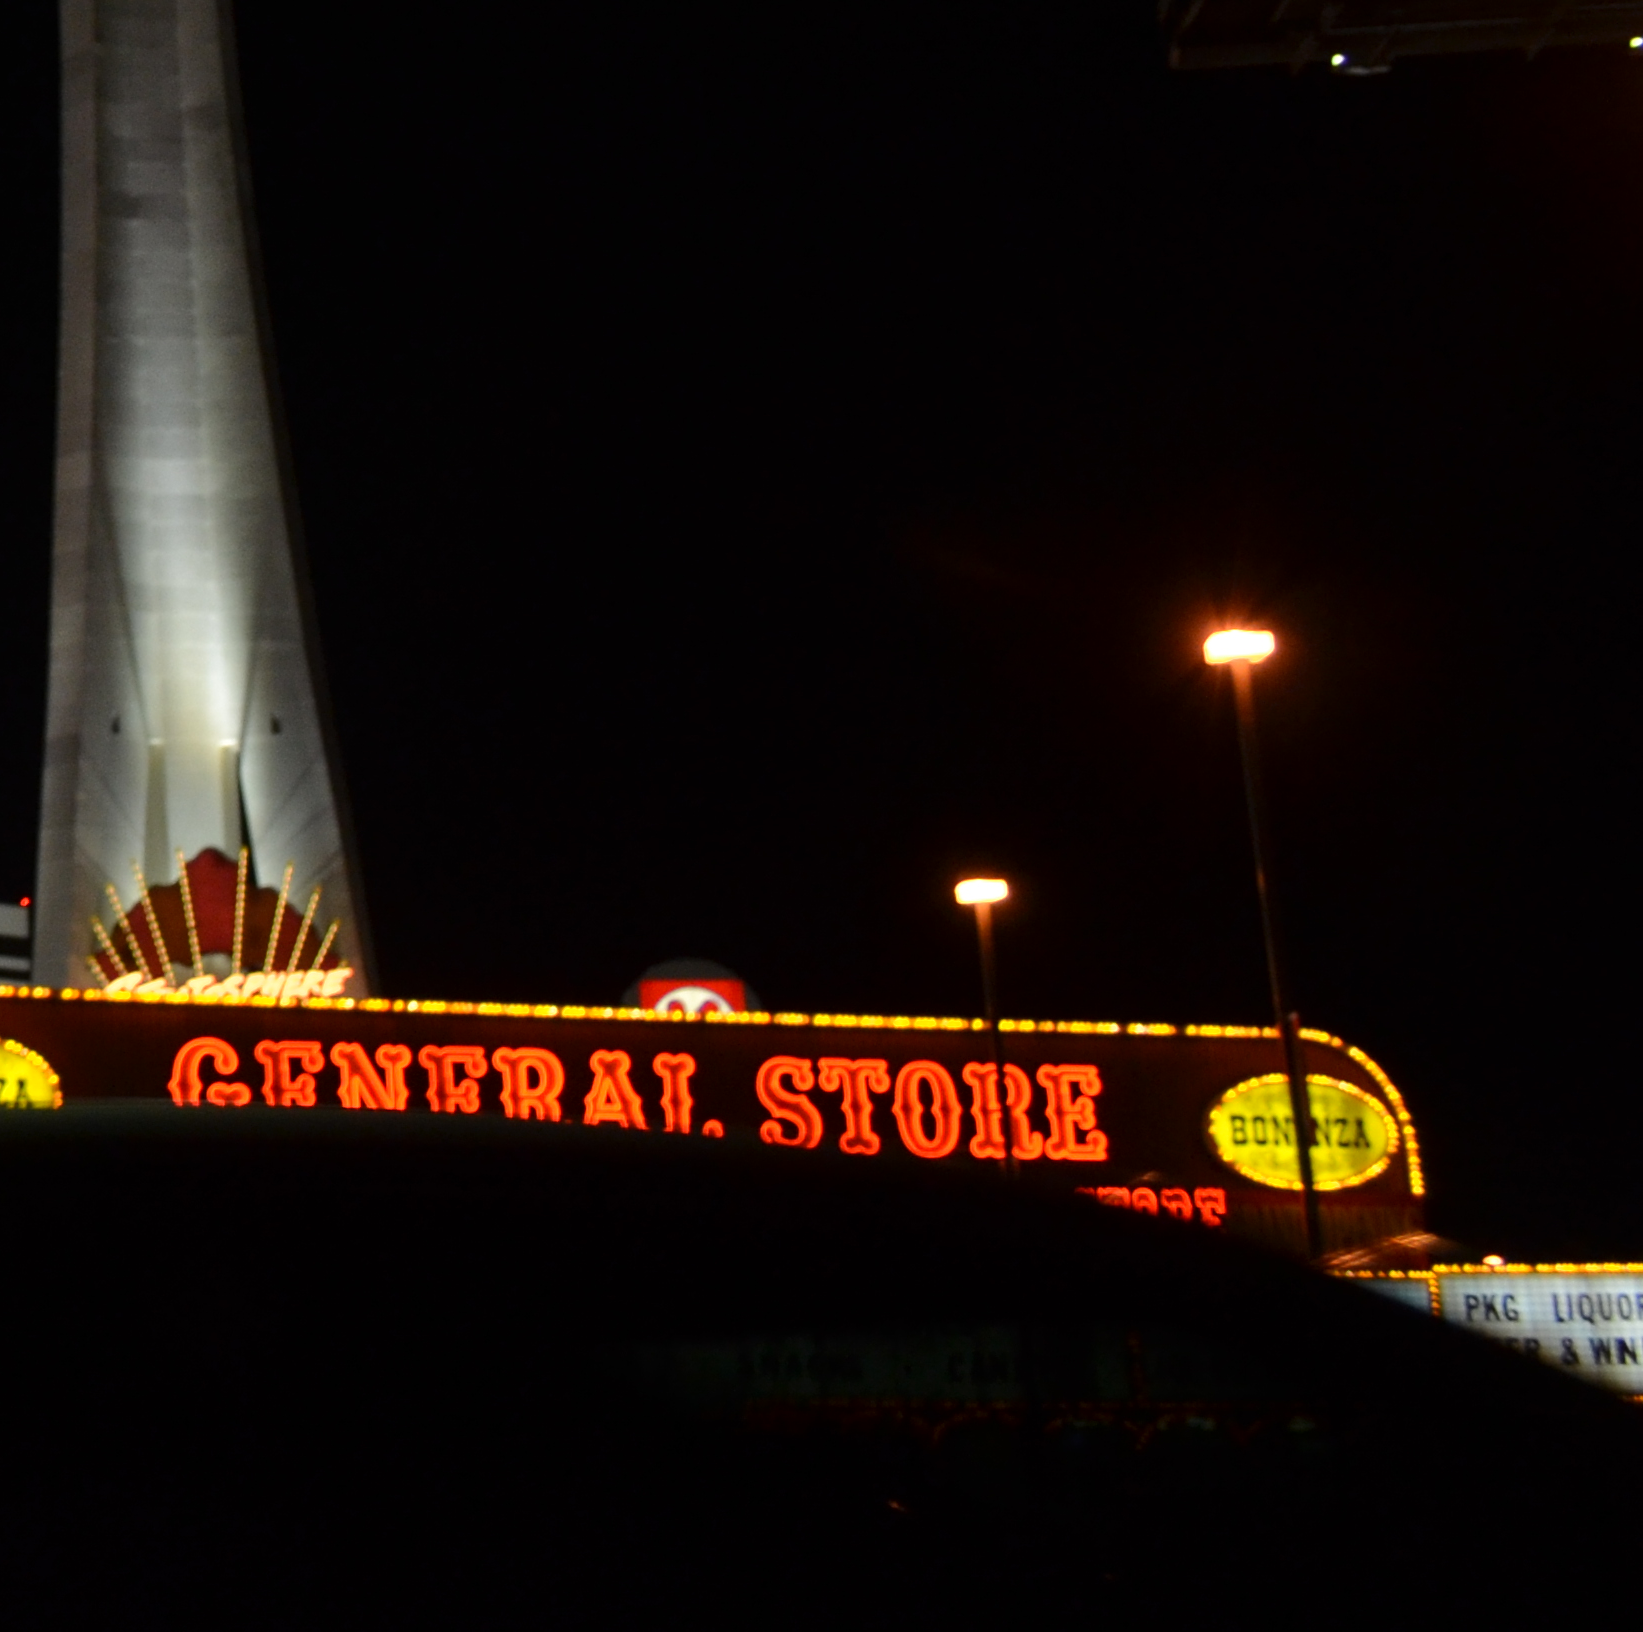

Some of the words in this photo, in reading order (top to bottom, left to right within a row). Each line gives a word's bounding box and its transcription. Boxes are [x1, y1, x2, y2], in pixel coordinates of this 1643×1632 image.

[168, 1036, 725, 1138] GENERAL
[755, 1054, 1109, 1162] STORE
[1230, 1114, 1371, 1150] BONNZA
[1464, 1292, 1520, 1323] PKG
[1561, 1337, 1581, 1366] &
